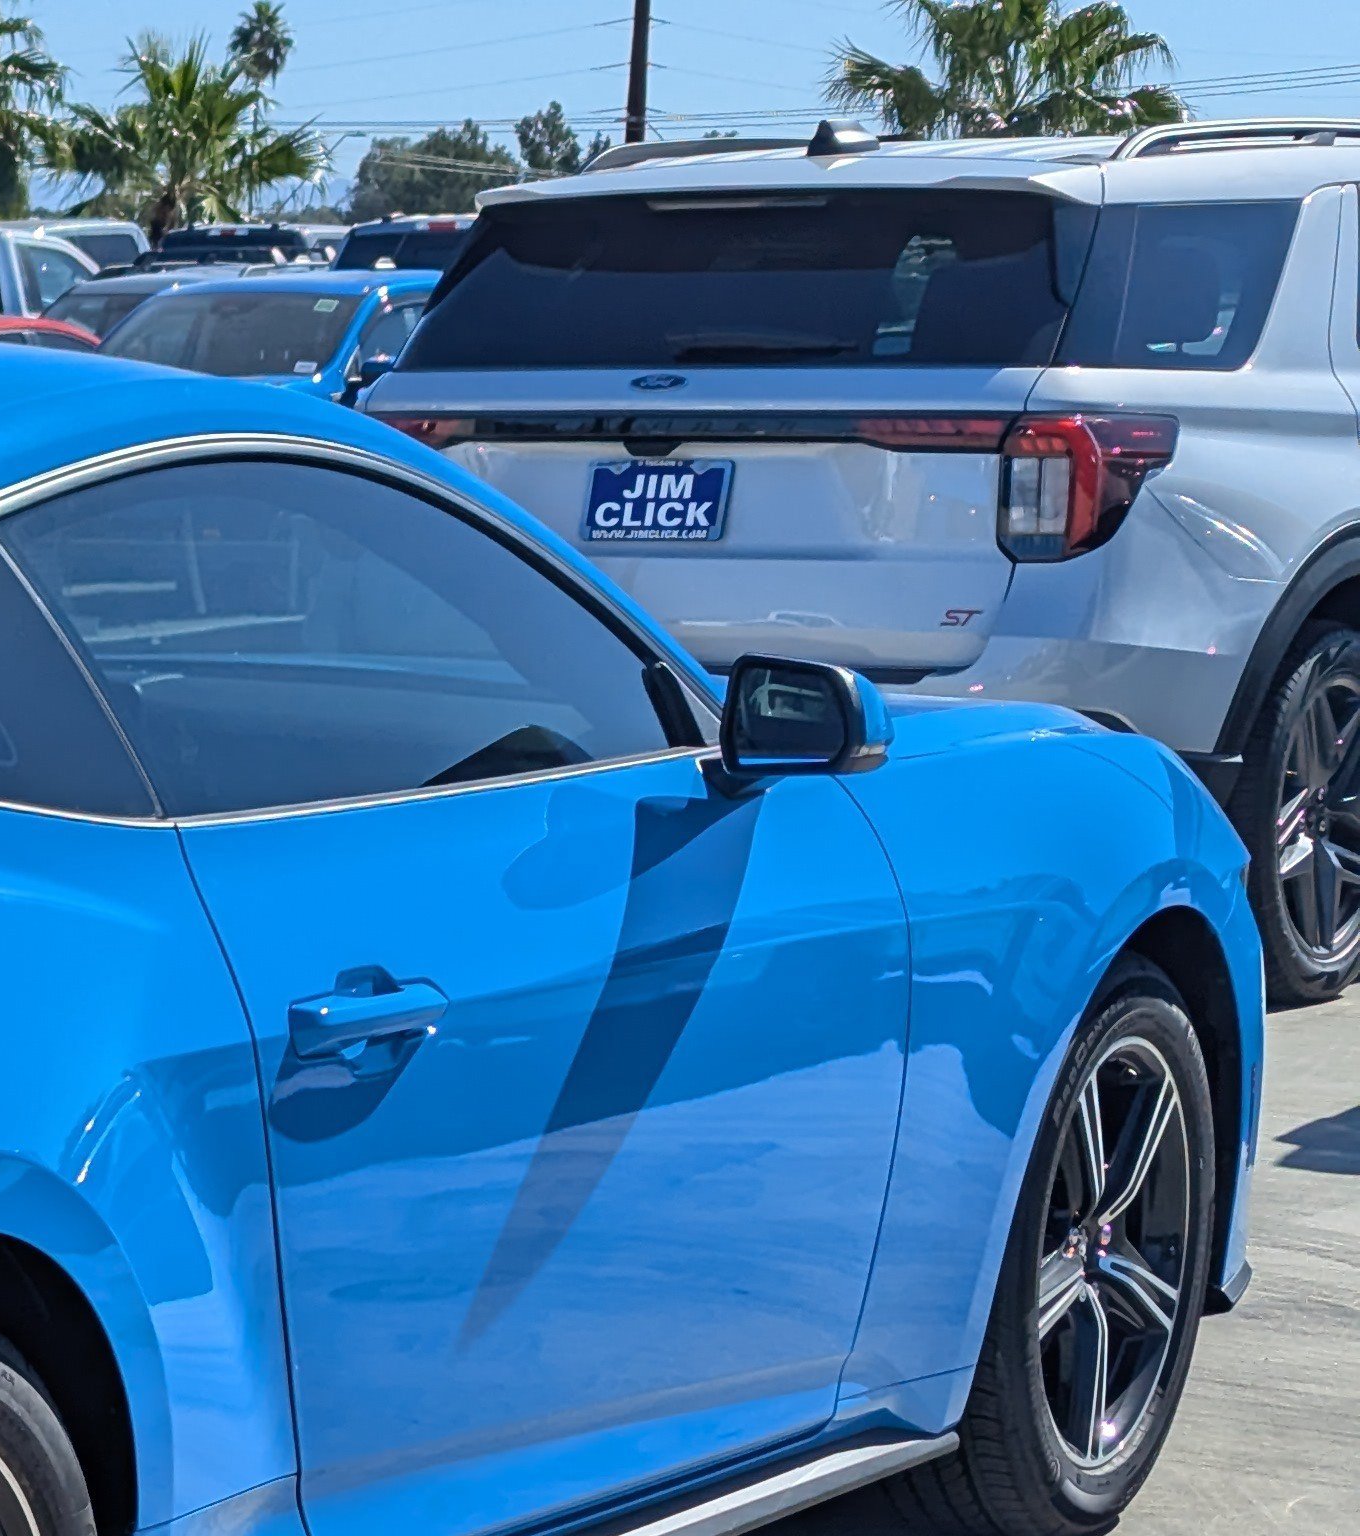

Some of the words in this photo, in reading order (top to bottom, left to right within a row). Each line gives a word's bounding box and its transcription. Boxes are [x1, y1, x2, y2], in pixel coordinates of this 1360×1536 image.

[622, 473, 695, 500] JIM
[594, 501, 714, 527] CLICK
[940, 609, 983, 626] ST
